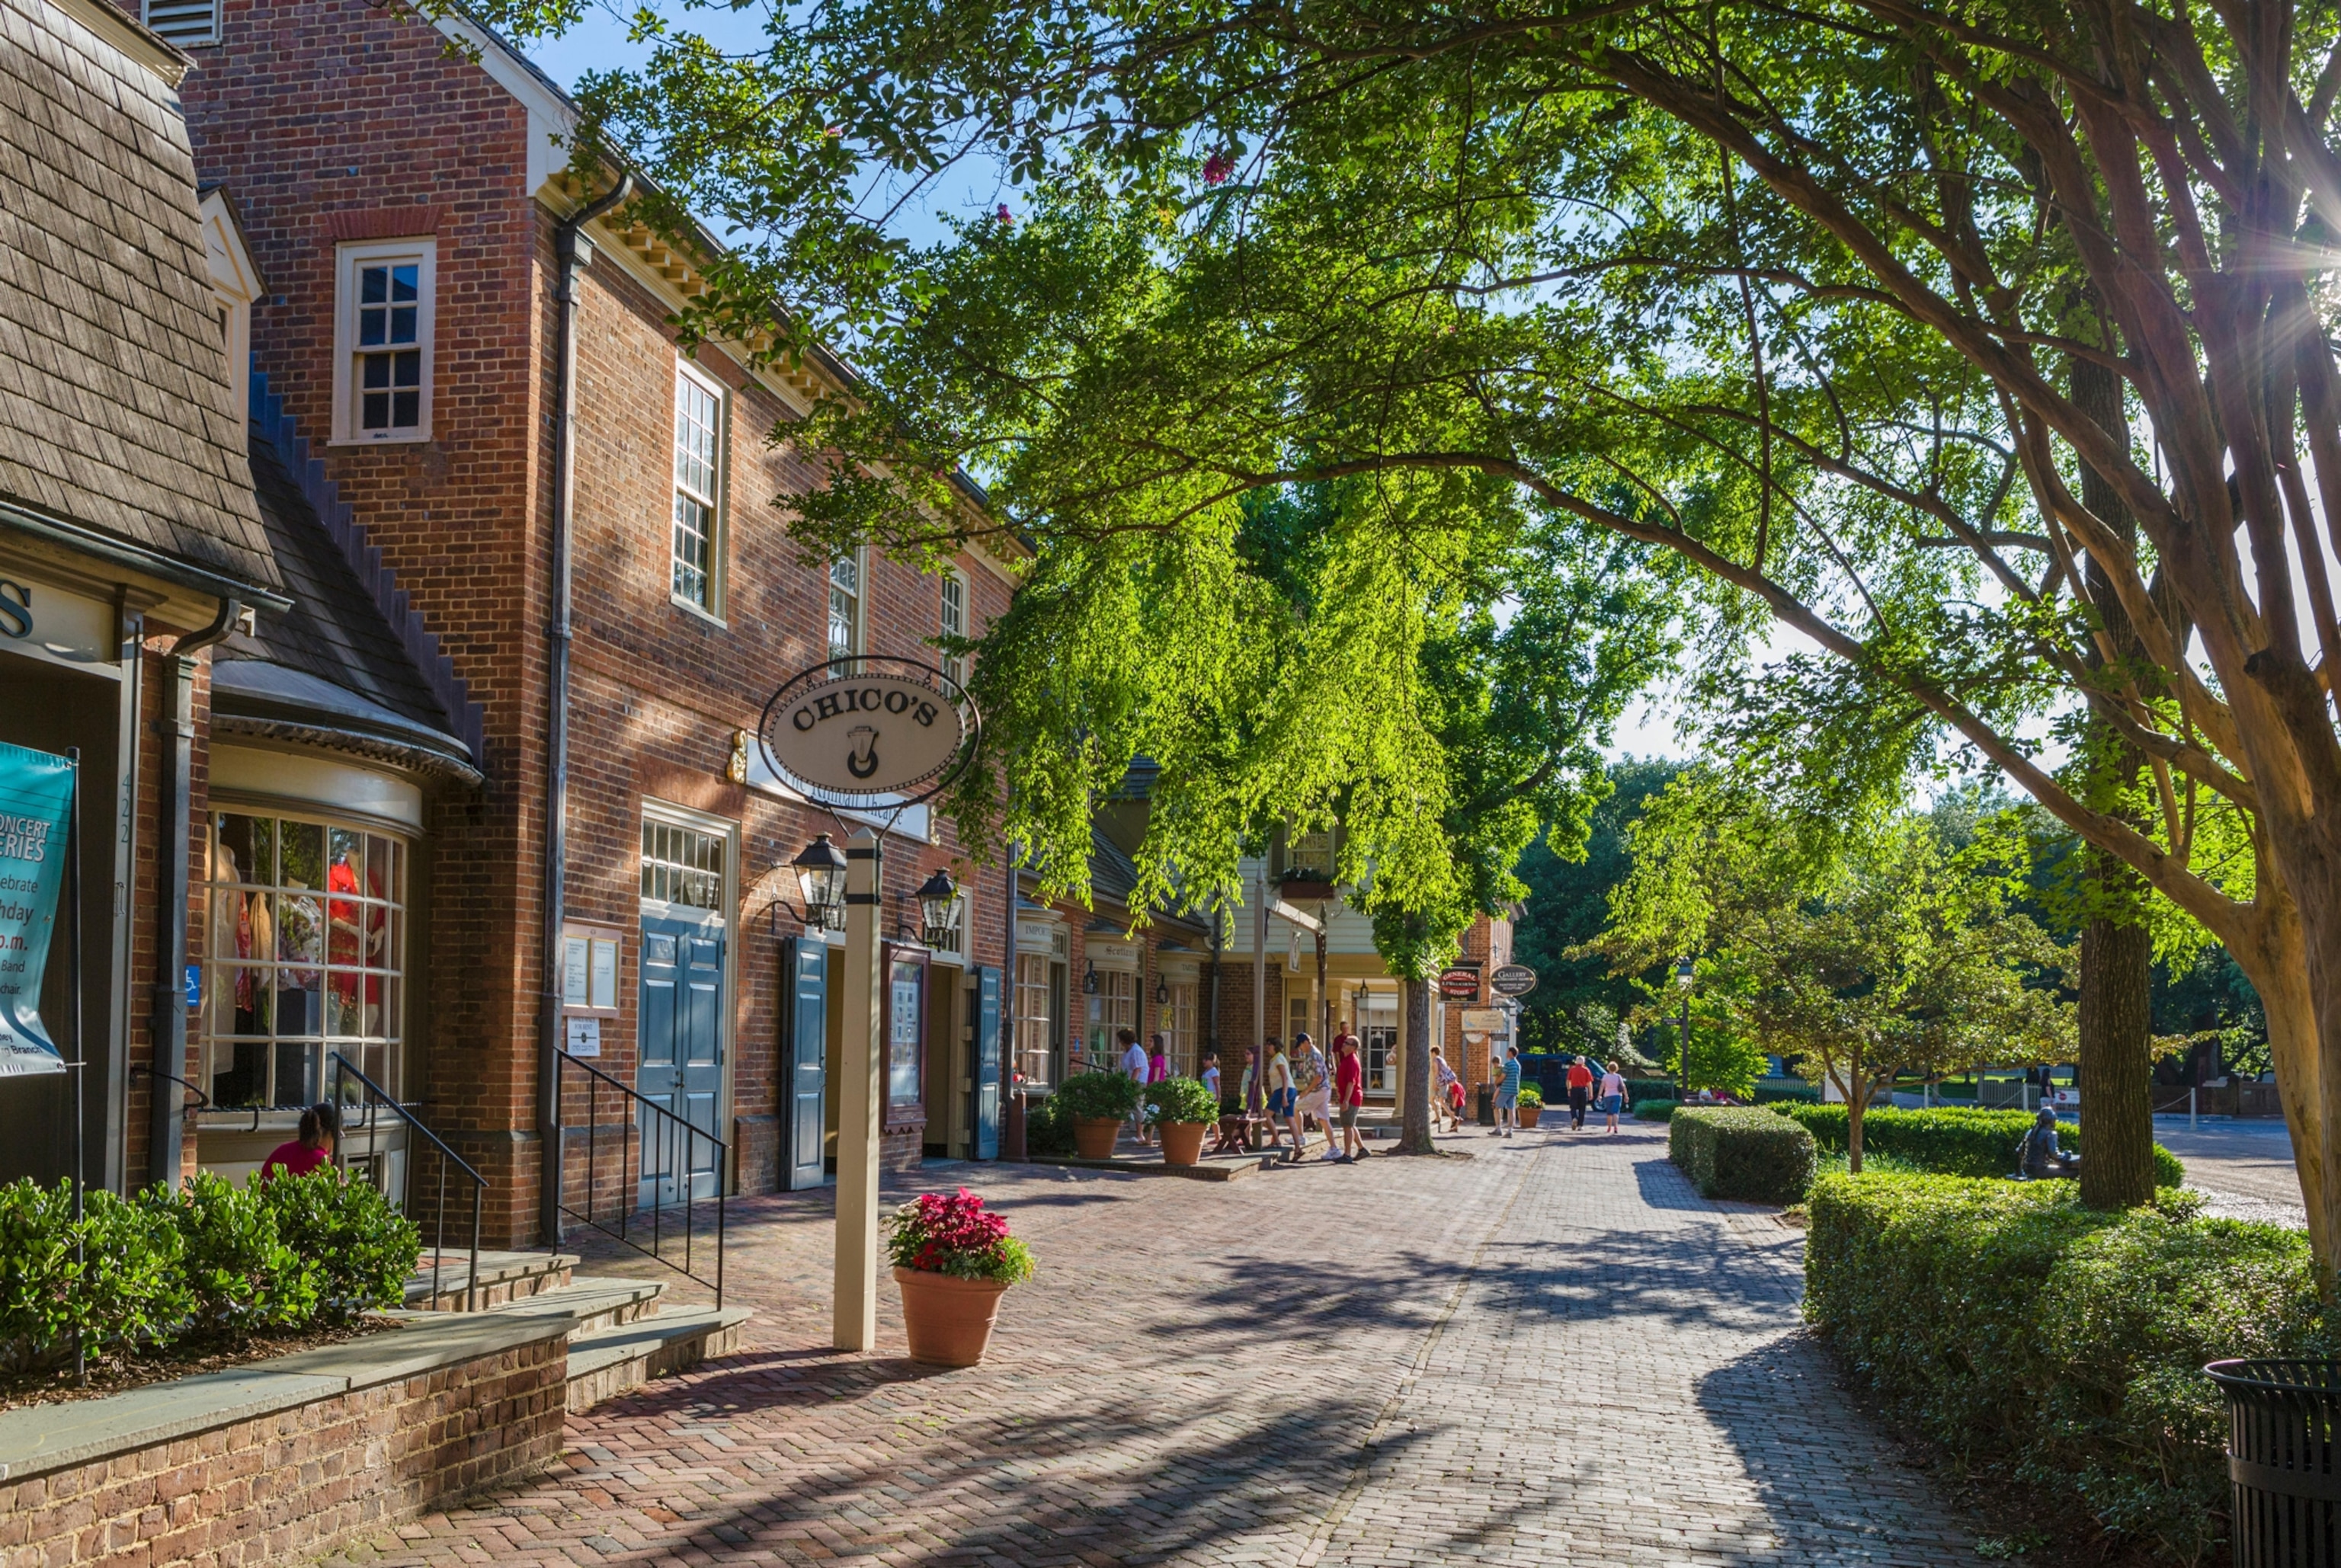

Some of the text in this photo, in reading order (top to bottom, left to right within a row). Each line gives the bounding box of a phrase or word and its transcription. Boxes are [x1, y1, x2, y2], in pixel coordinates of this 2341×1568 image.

[793, 688, 939, 731] CHICO'S
[2, 959, 25, 973] Band
[1443, 971, 1476, 981] GENERAL
[1497, 971, 1527, 979] GALLERY
[11, 1045, 43, 1055] Branch
